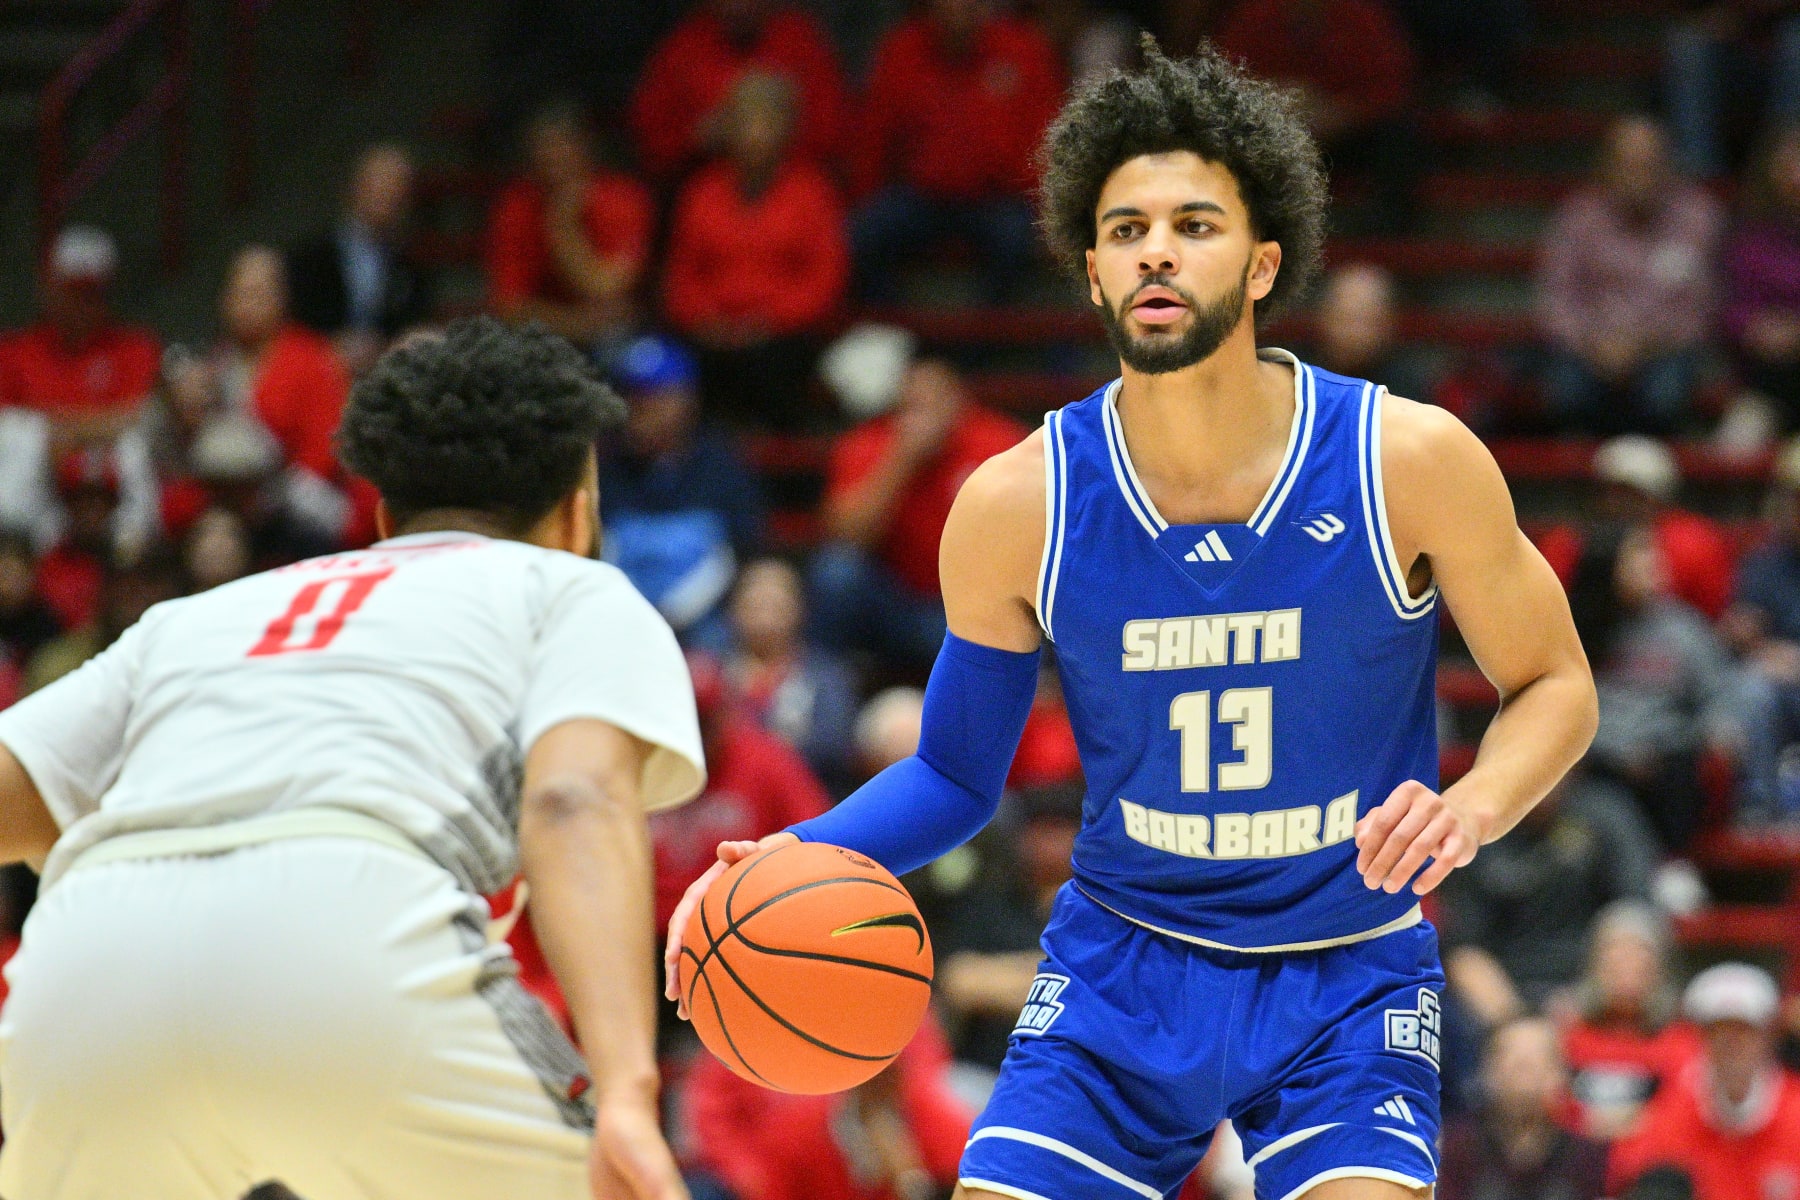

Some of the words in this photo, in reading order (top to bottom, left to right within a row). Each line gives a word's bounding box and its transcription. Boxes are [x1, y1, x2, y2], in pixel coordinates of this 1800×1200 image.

[246, 566, 396, 657] 0
[1122, 607, 1302, 671] SANTA
[1169, 686, 1273, 792] 13
[1118, 789, 1359, 861] BARBARA
[1027, 978, 1065, 1003] TA
